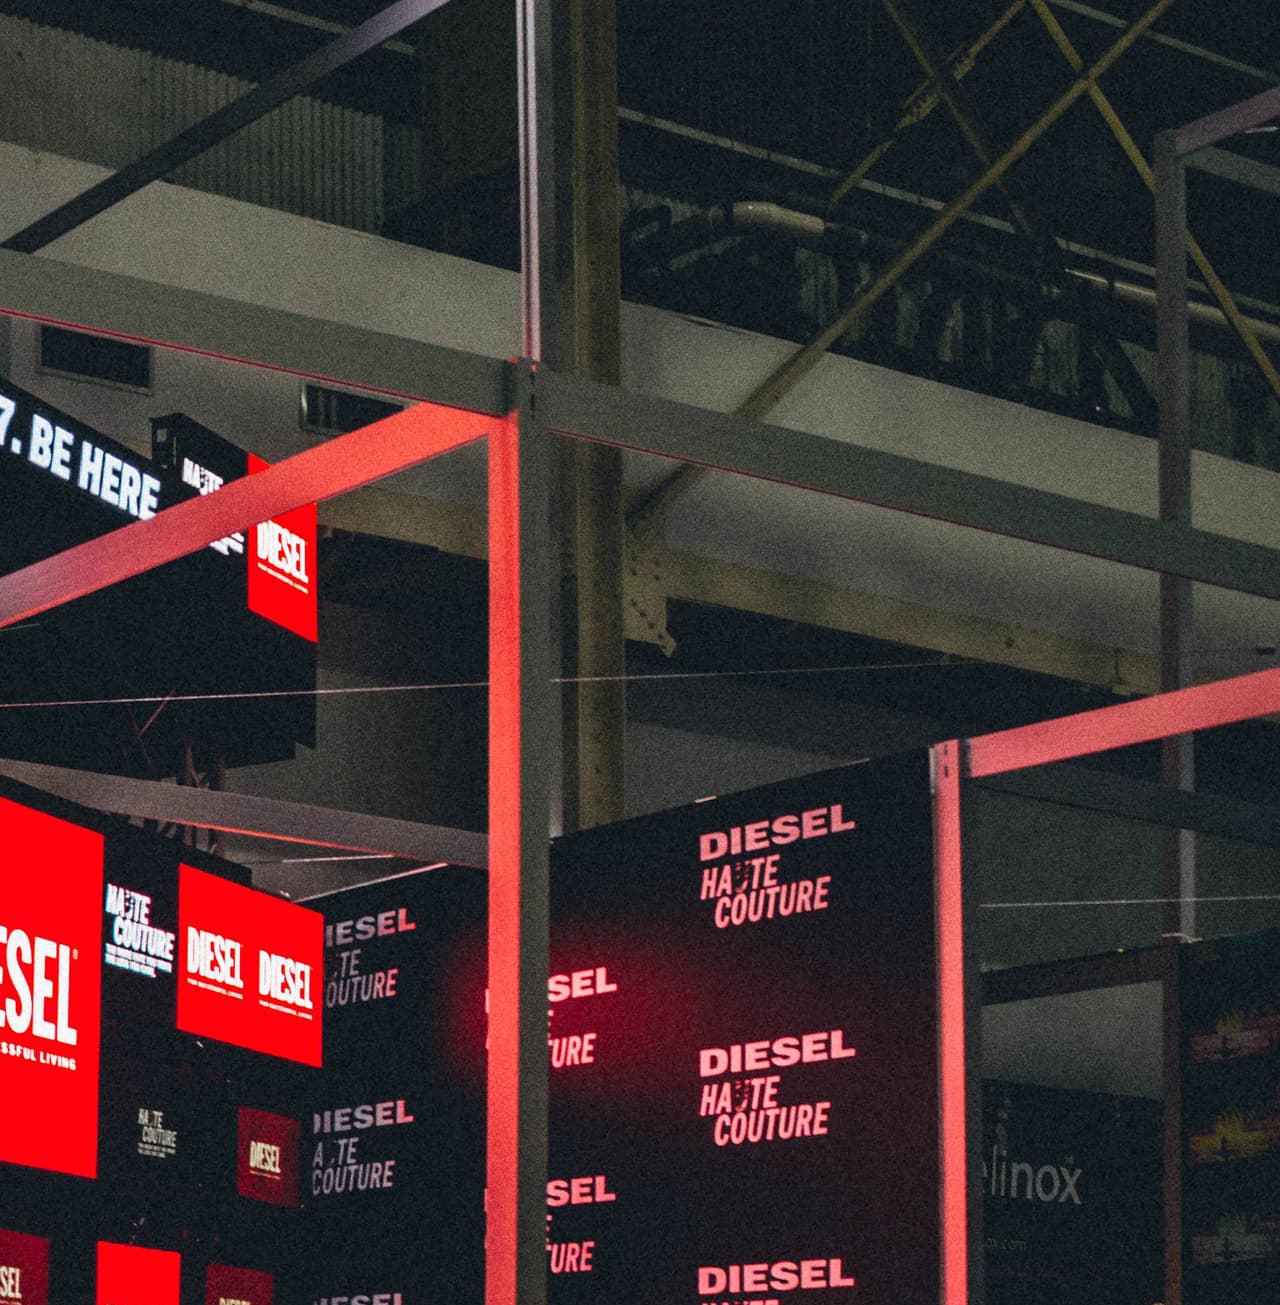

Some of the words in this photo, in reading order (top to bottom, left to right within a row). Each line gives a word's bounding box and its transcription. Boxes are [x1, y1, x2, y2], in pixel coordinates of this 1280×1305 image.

[29, 413, 74, 480] BE
[77, 440, 161, 520] HERE
[257, 520, 309, 584] DIESEL
[699, 803, 856, 862] DIESEL
[714, 875, 832, 929] COUTURE
[113, 914, 175, 961] COUTURE
[325, 907, 417, 947] IESEL
[187, 925, 244, 989] DIESEL
[259, 949, 313, 1010] DIESEL
[326, 967, 400, 1008] OUTURE
[39, 1051, 77, 1071] LIVING
[699, 1029, 857, 1078] DIESEL
[138, 1108, 164, 1129] HATE
[714, 1101, 832, 1147] COUTURE
[250, 1140, 281, 1174] DIESEL
[698, 1258, 855, 1296] DIESEL
